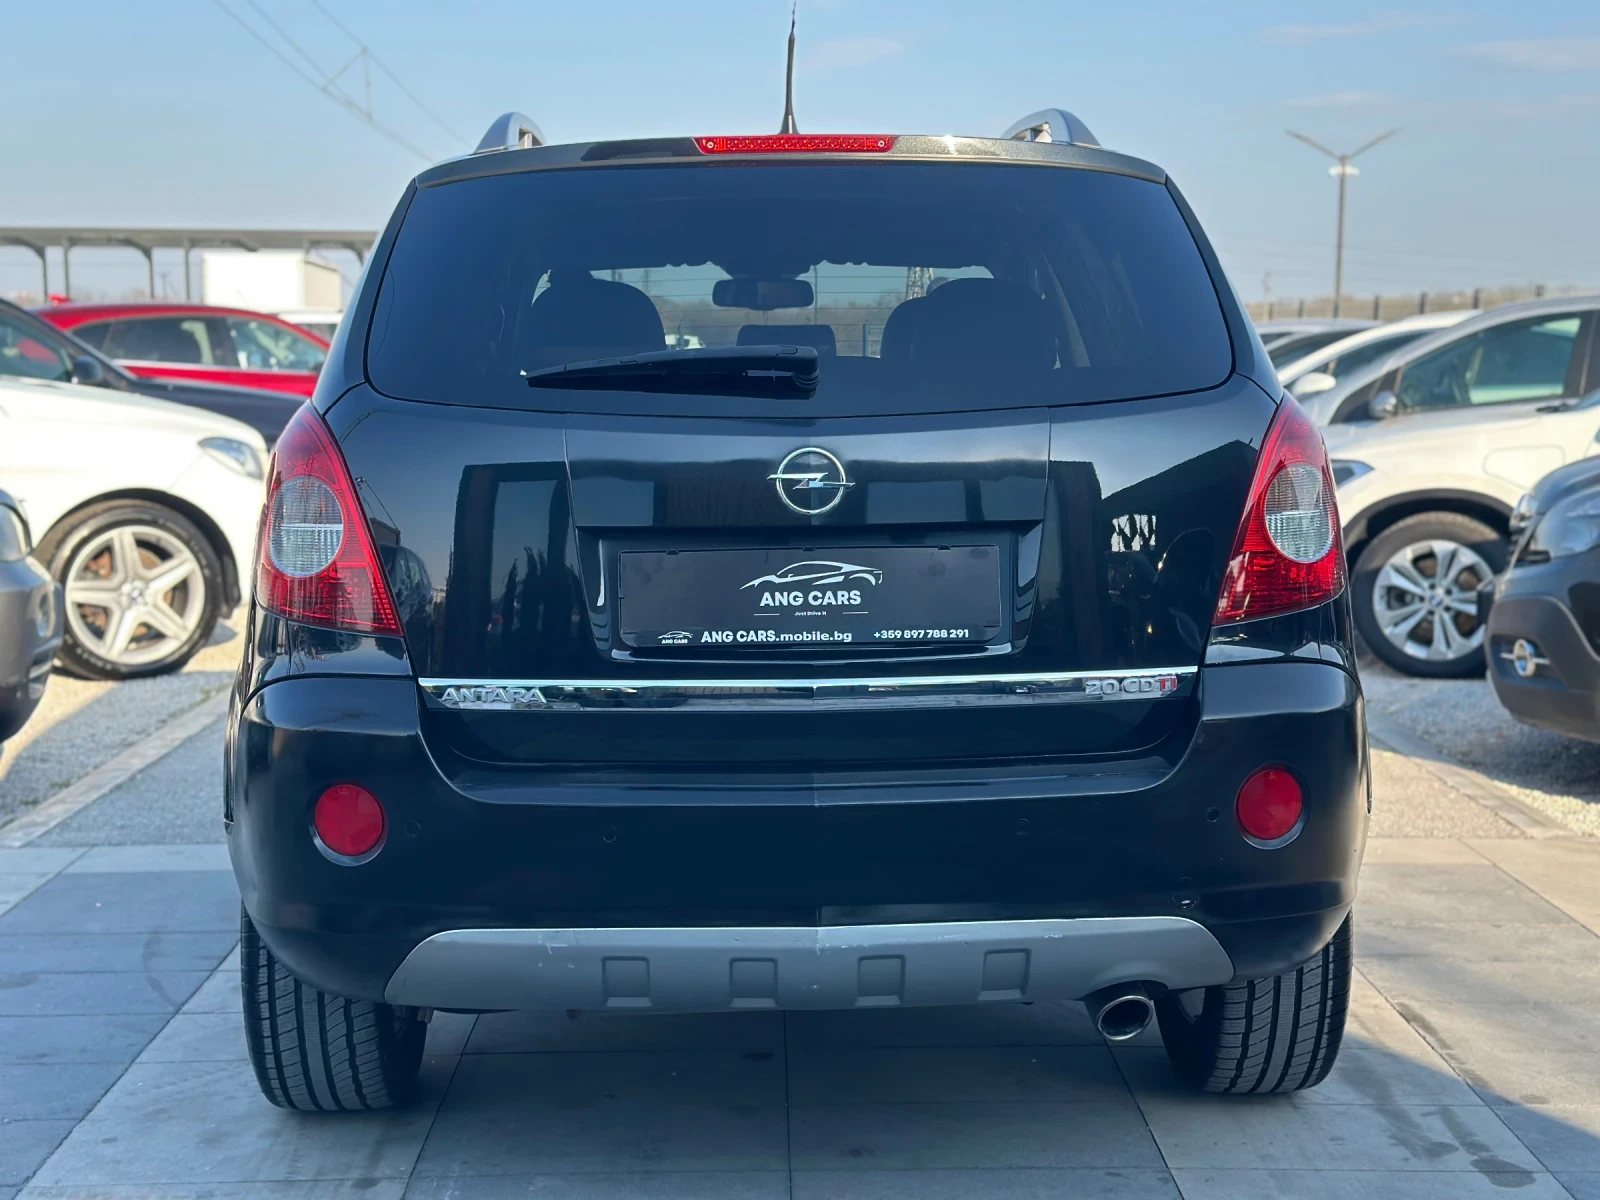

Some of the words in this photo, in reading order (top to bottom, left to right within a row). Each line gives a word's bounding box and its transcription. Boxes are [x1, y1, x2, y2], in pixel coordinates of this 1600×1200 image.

[759, 591, 804, 606] ANG
[808, 590, 862, 605] CARS
[700, 630, 734, 643] ANG
[736, 630, 852, 643] CARS.mobile.bg
[873, 630, 902, 639] +359
[903, 629, 925, 638] 897
[926, 629, 948, 638] 788
[949, 629, 969, 638] 291
[441, 687, 547, 703] ANTARA
